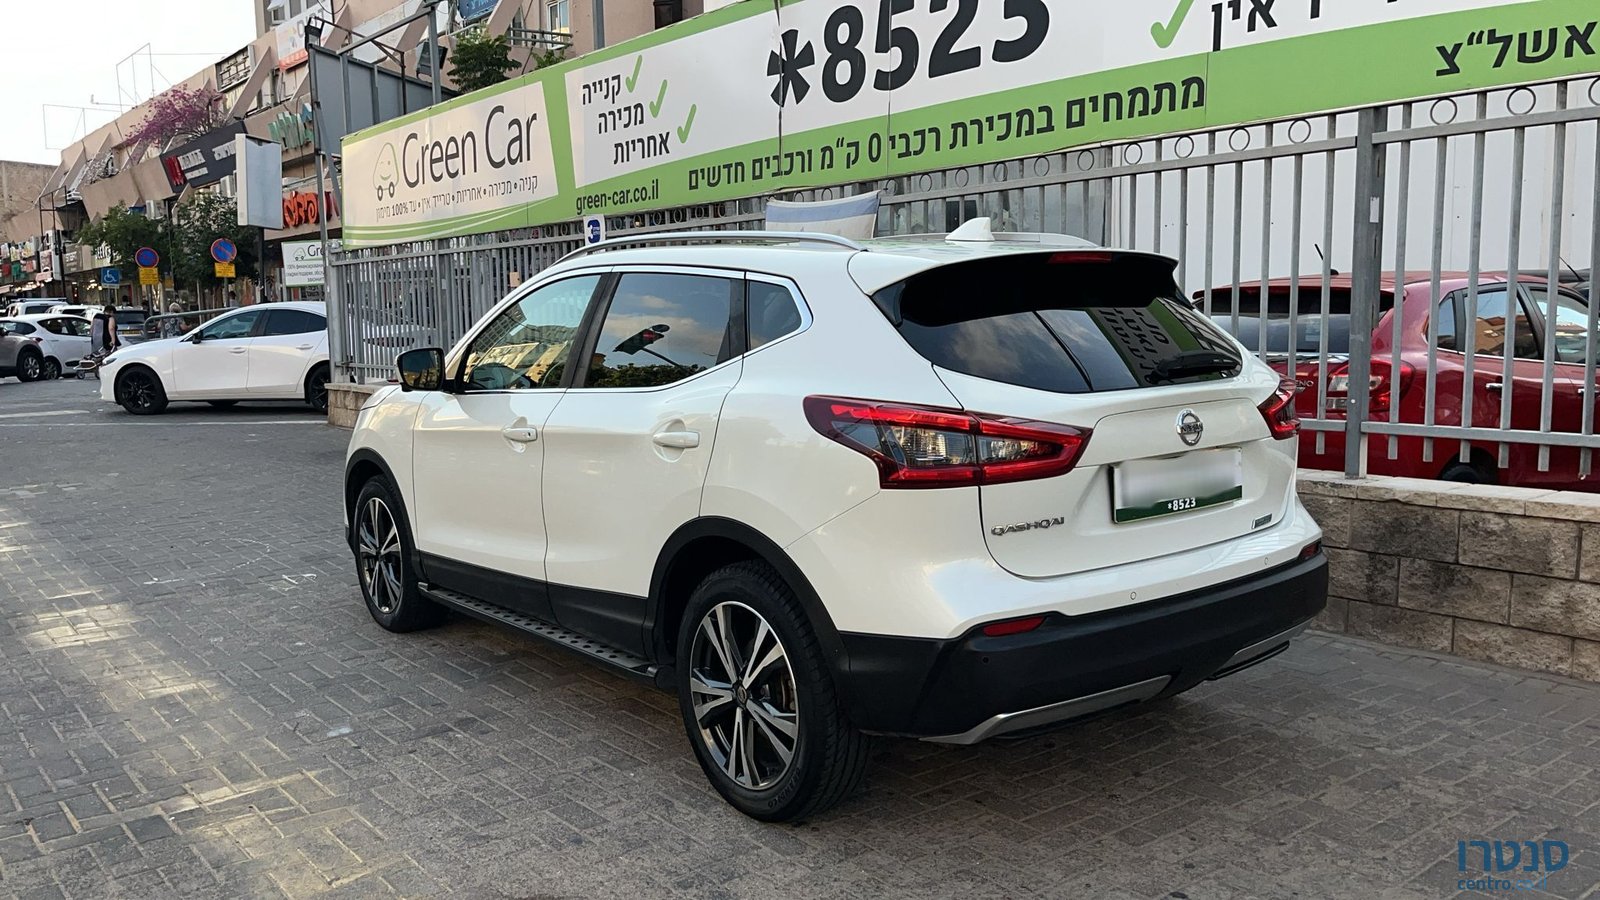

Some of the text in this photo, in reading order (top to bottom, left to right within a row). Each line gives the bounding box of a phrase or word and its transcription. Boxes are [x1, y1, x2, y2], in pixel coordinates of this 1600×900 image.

[1211, 0, 1277, 52] אין
[582, 74, 622, 105] קנייה
[1066, 75, 1205, 129] מתמחים
[598, 102, 644, 135] מכירה
[950, 104, 1055, 151] במכירת
[402, 105, 537, 189] Green Car
[614, 131, 670, 165] אחריות
[867, 131, 882, 164] 0
[889, 125, 941, 158] רכבי
[688, 161, 745, 191] חדשים
[751, 149, 813, 182] ורכבים
[433, 191, 451, 208] טרייד
[456, 186, 482, 204] אחריות
[489, 180, 512, 197] מכירה
[519, 175, 538, 194] קניה
[576, 178, 659, 215] green-car.co.il
[392, 202, 409, 216] 100%
[991, 517, 1065, 535] QASHQAI
